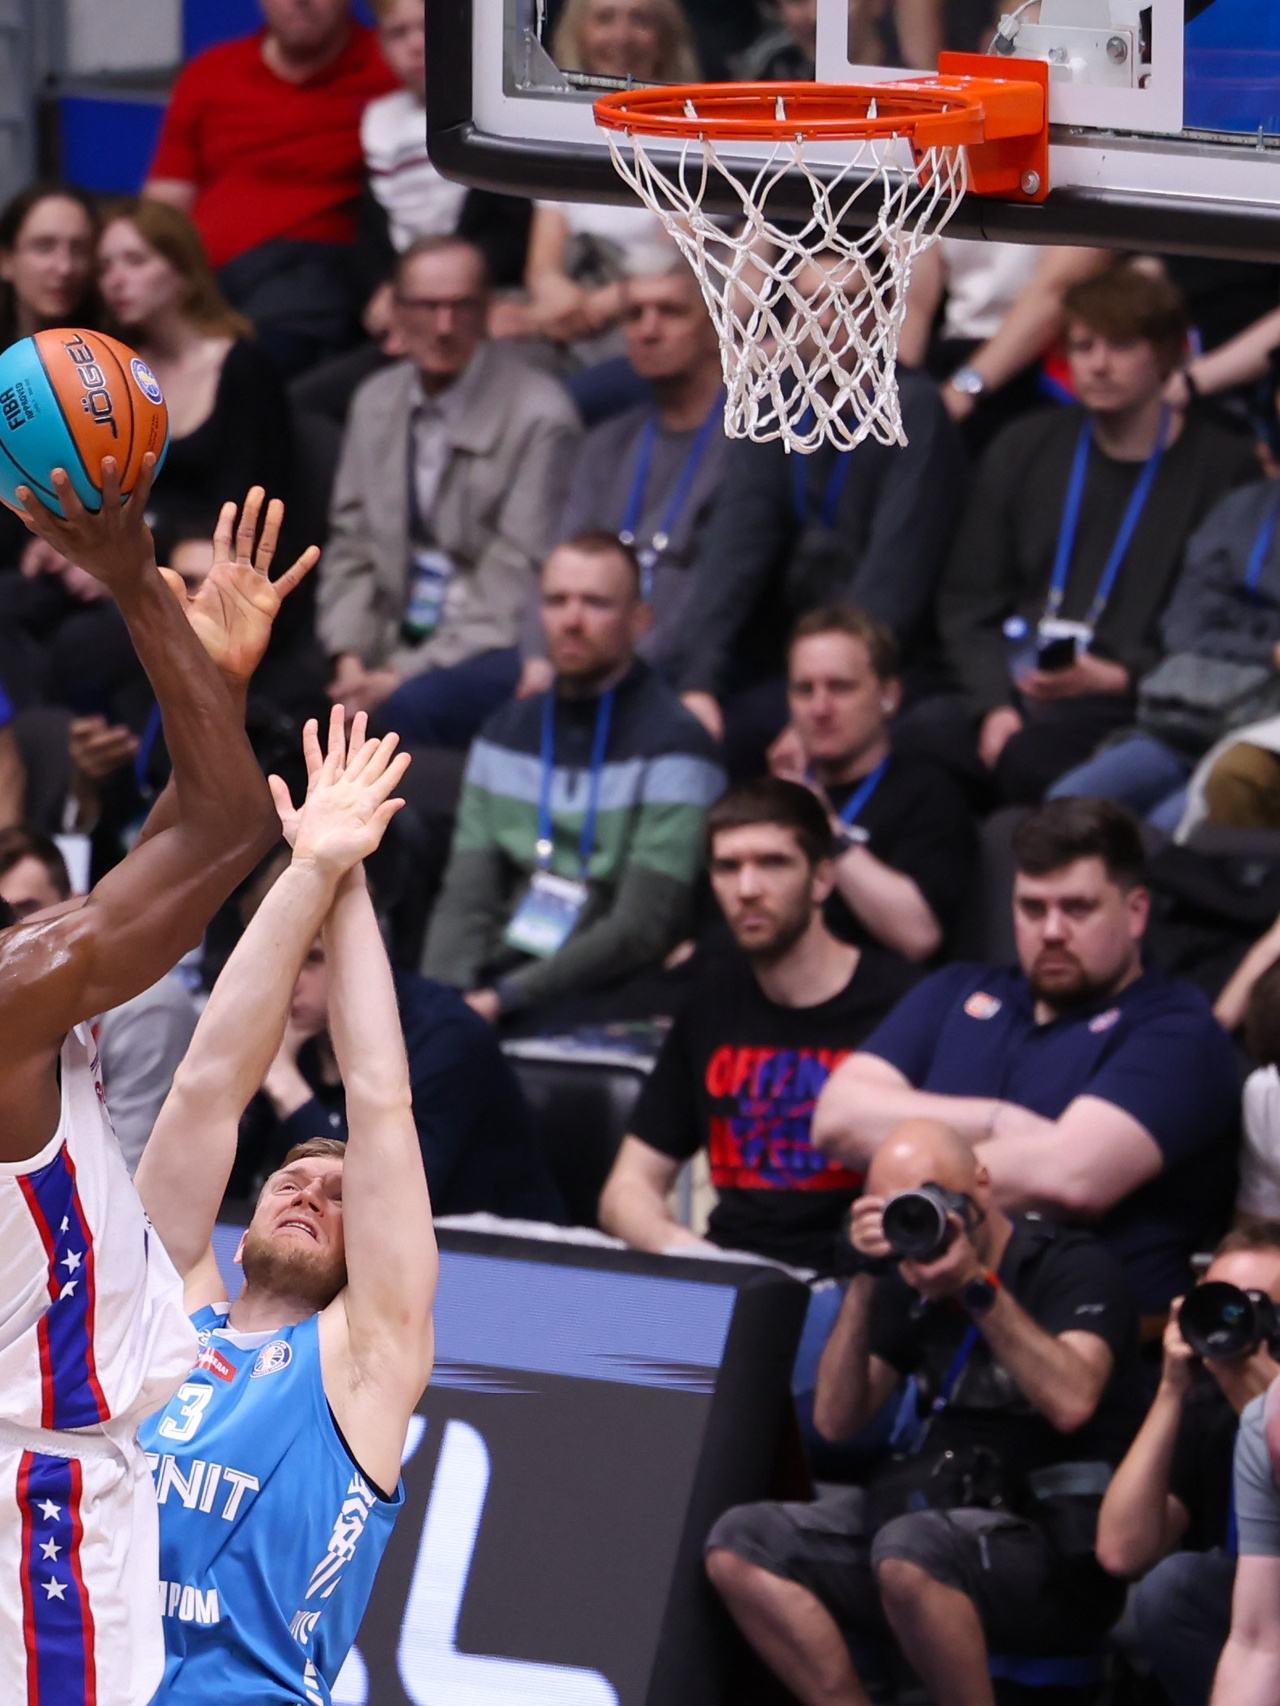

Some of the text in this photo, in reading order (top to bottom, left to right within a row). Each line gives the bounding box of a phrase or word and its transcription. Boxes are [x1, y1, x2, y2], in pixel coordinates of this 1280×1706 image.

[15, 382, 36, 421] APPROVED
[62, 333, 118, 439] JÖGEL
[158, 1382, 214, 1441] 3
